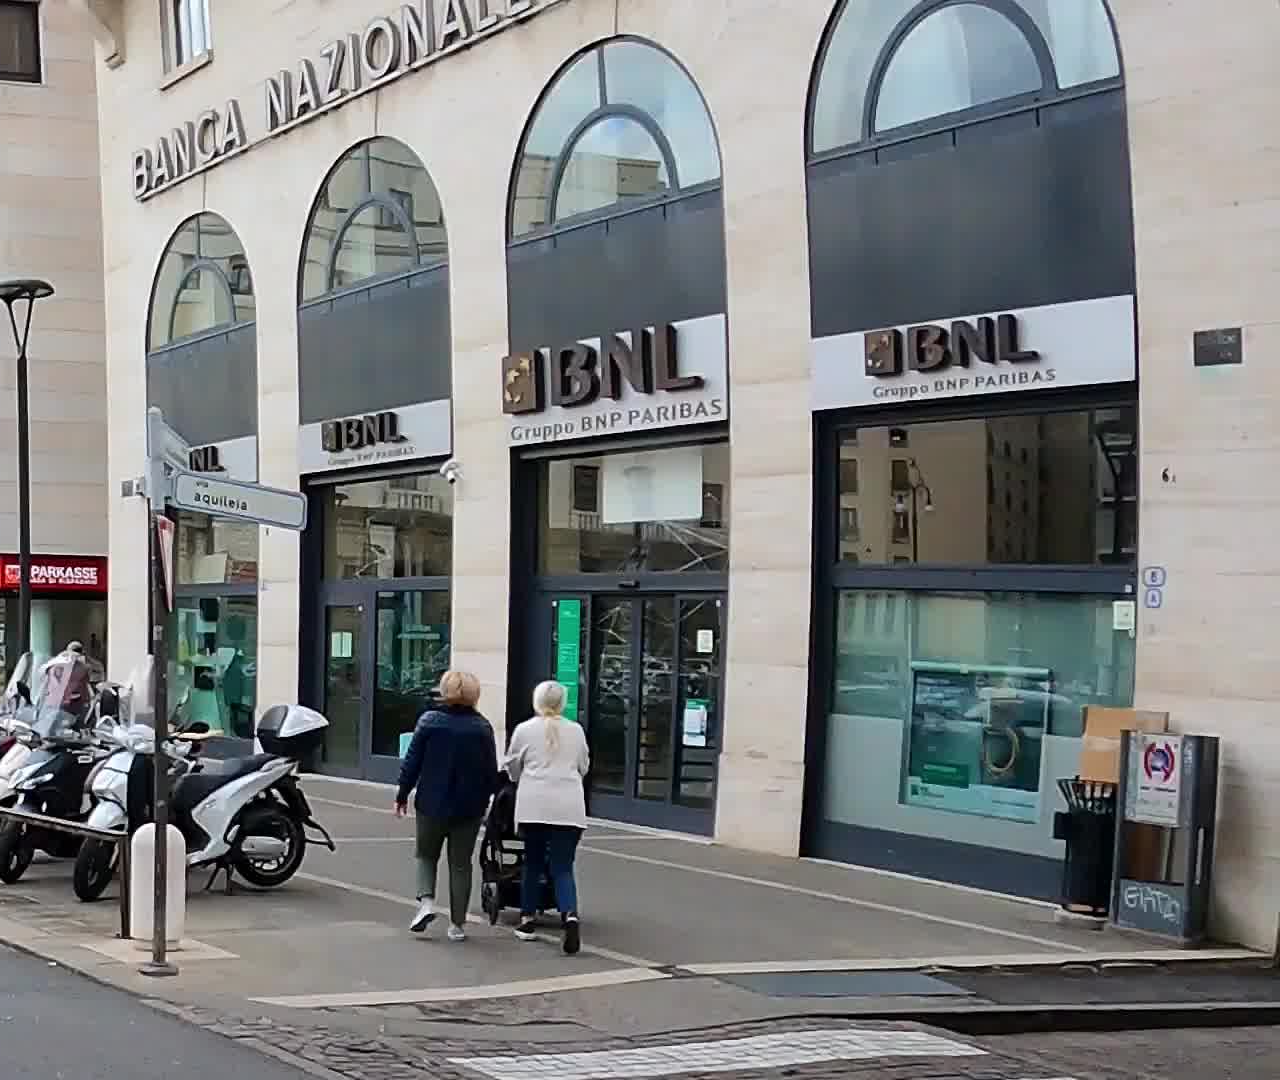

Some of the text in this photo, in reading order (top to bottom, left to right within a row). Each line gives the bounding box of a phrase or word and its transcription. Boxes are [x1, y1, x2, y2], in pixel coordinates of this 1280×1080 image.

[132, 0, 536, 198] BANCA NAZIONAL
[907, 313, 1041, 372] BNL
[551, 326, 705, 408] BNL
[873, 369, 1057, 400] Gruppo BNP PARIBAS
[341, 411, 408, 449] BNL
[510, 398, 723, 442] Gruppo BNP PARIBAS
[189, 446, 225, 472] NL
[193, 490, 249, 511] aquileia
[30, 565, 98, 578] PARKASSE
